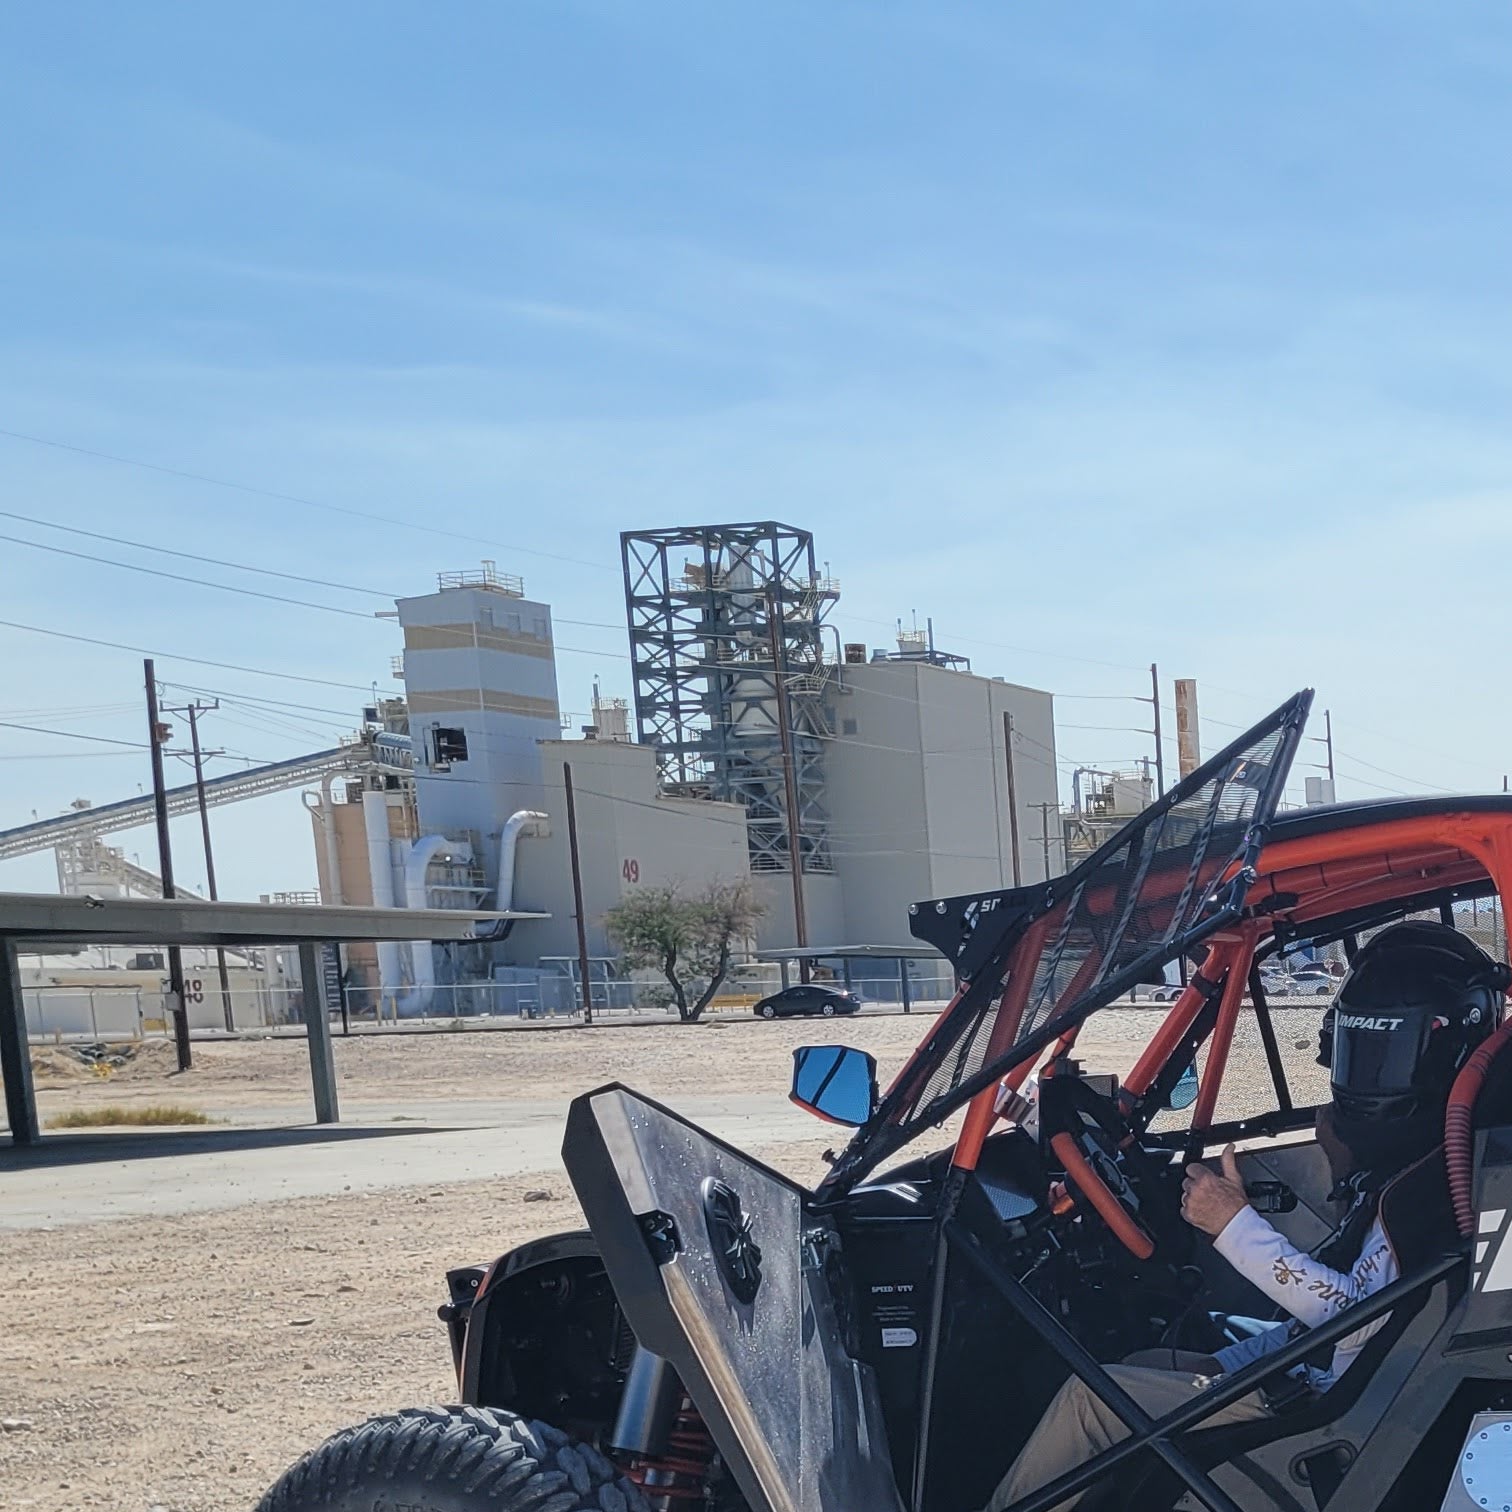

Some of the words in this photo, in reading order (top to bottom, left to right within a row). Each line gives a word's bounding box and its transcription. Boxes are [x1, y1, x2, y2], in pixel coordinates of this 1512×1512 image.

[622, 859, 639, 883] 49
[1338, 1013, 1404, 1032] IMPACT
[871, 1285, 894, 1293] SPEED
[897, 1284, 914, 1292] UTV
